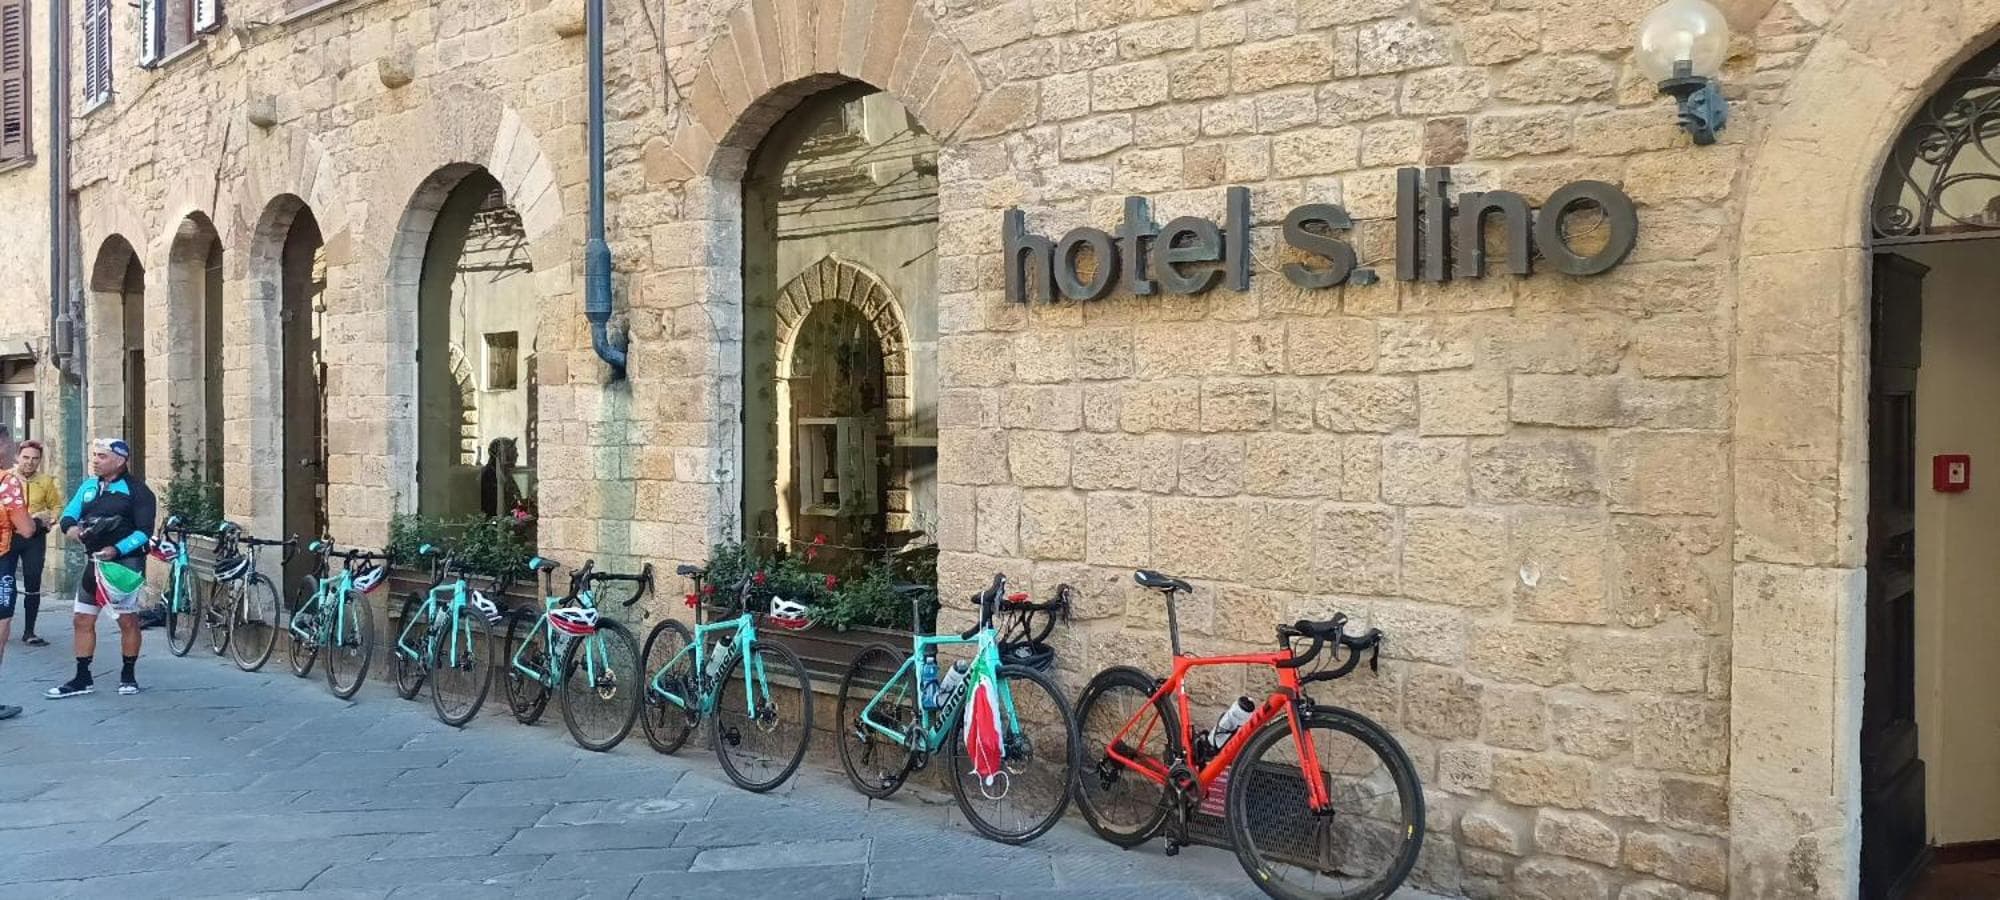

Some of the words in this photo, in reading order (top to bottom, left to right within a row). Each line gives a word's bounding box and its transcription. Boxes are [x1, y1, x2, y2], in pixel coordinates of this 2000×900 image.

[1002, 186, 1250, 304] hotel
[1281, 203, 1379, 289] s.
[1396, 167, 1638, 281] lino
